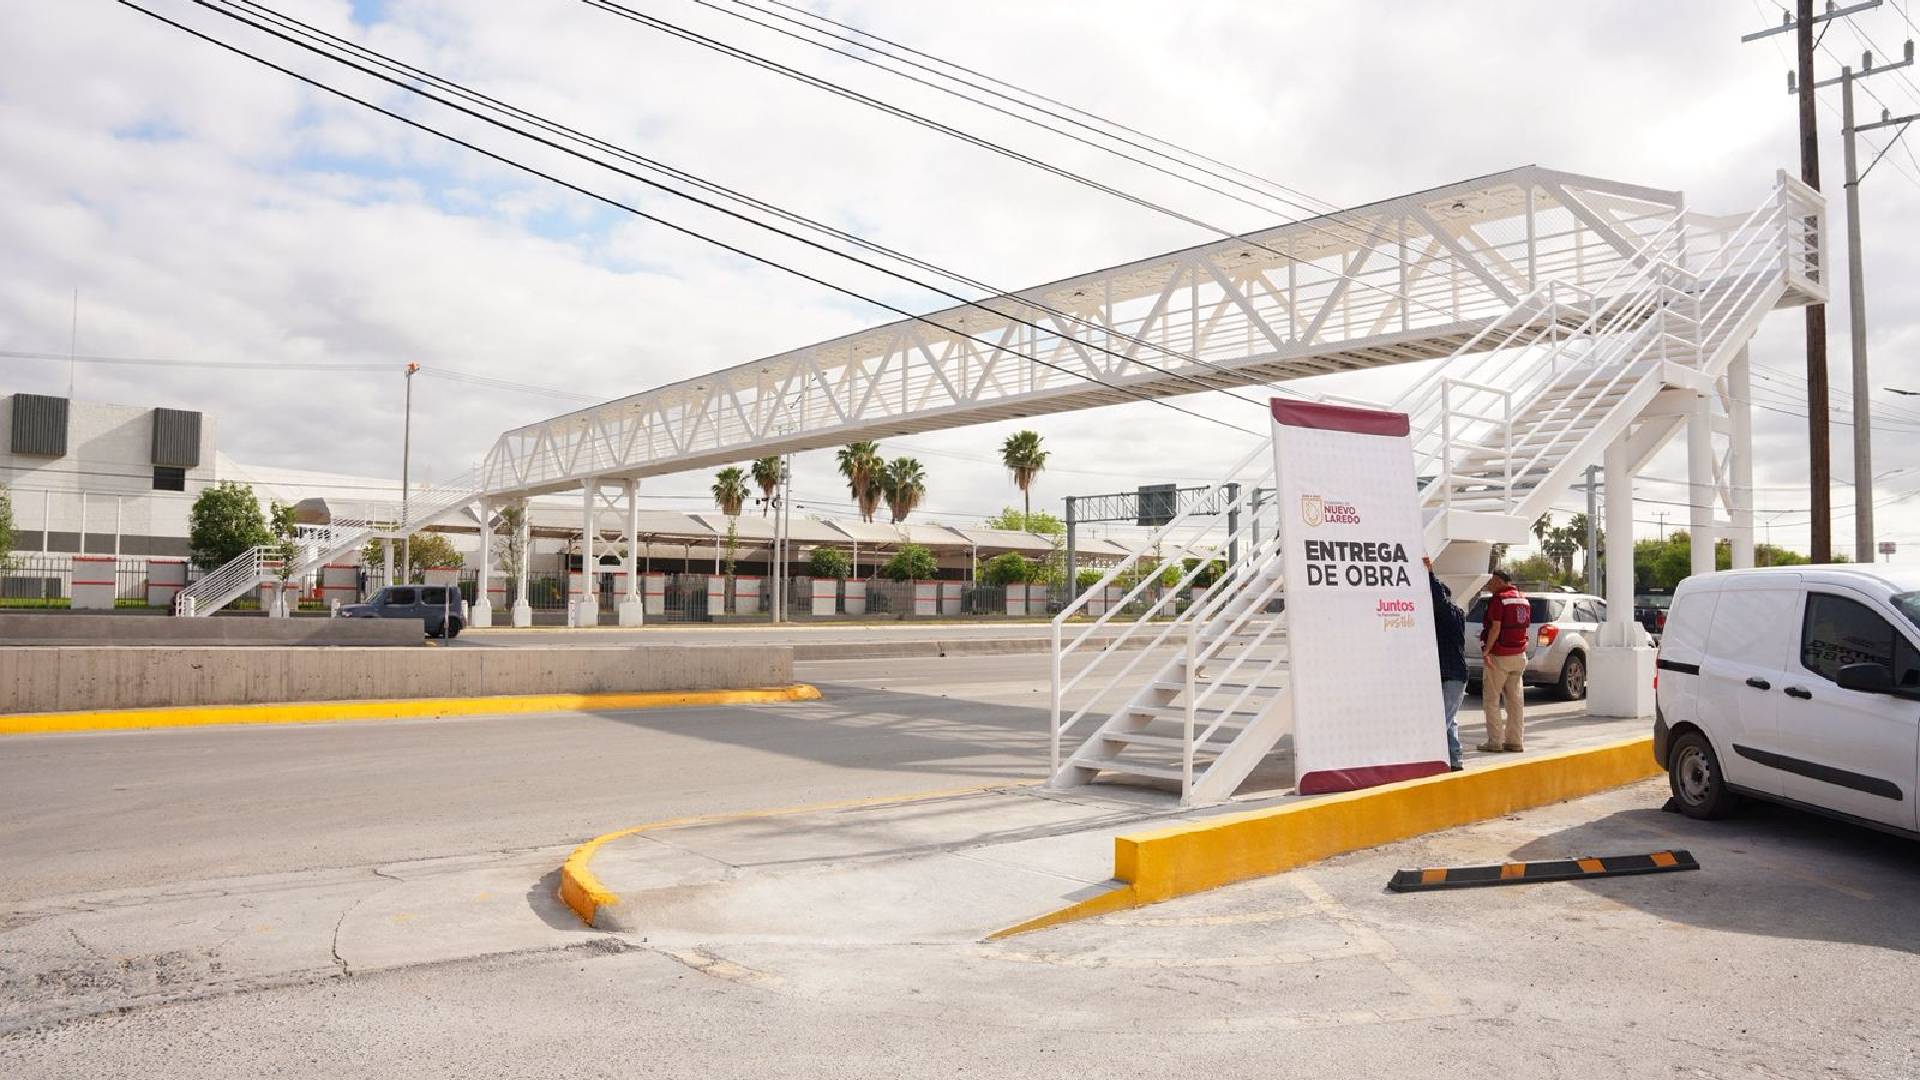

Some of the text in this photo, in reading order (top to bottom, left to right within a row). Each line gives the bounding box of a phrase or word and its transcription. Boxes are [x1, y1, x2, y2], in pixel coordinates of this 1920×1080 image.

[1324, 505, 1355, 515] NUEVO
[1325, 514, 1360, 524] LAREDO
[1304, 539, 1408, 562] ENTREGA
[1306, 564, 1411, 587] DE OBRA
[1376, 599, 1415, 611] Juntos
